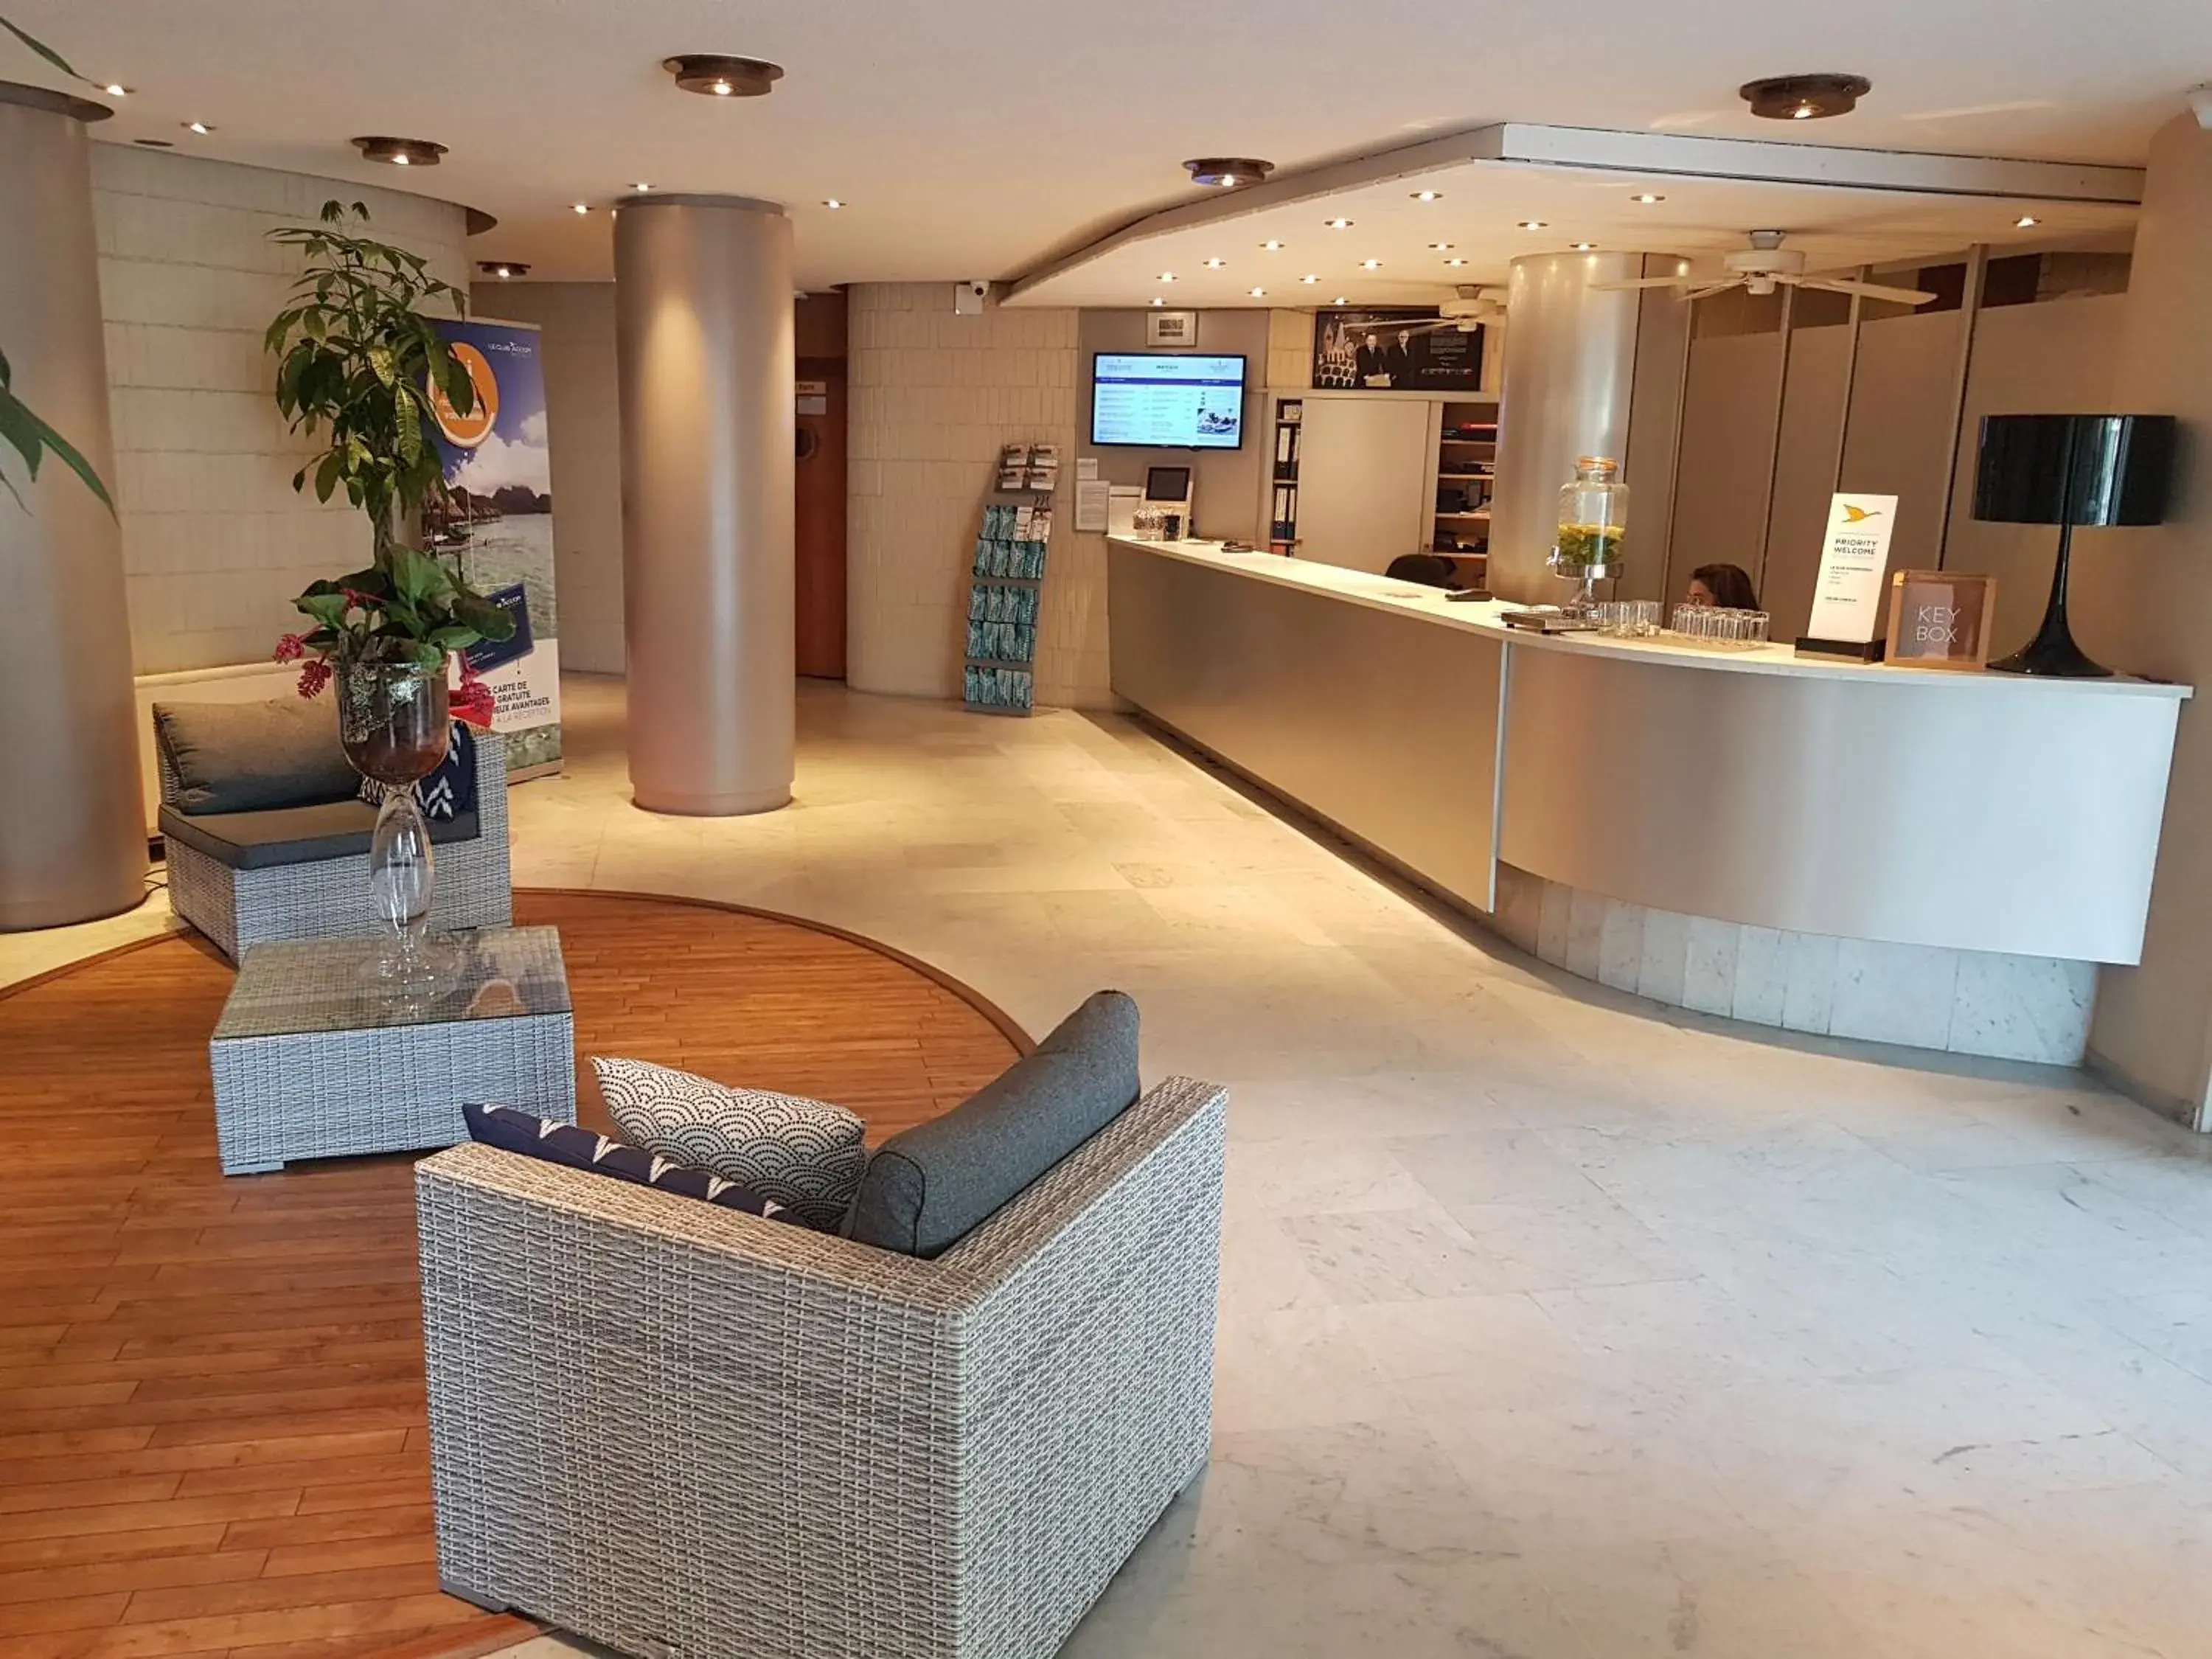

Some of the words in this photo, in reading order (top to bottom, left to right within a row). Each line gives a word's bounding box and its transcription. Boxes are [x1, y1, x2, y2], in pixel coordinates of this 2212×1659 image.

[1834, 538, 1879, 547] PRIORITY
[1834, 546, 1877, 555] WELCOME
[1918, 605, 1961, 623] KEY
[1916, 625, 1958, 643] BOX
[493, 683, 516, 694] CARTE
[517, 681, 528, 690] DE
[497, 690, 531, 703] GRATUITE
[511, 696, 550, 710] AVANTAGES
